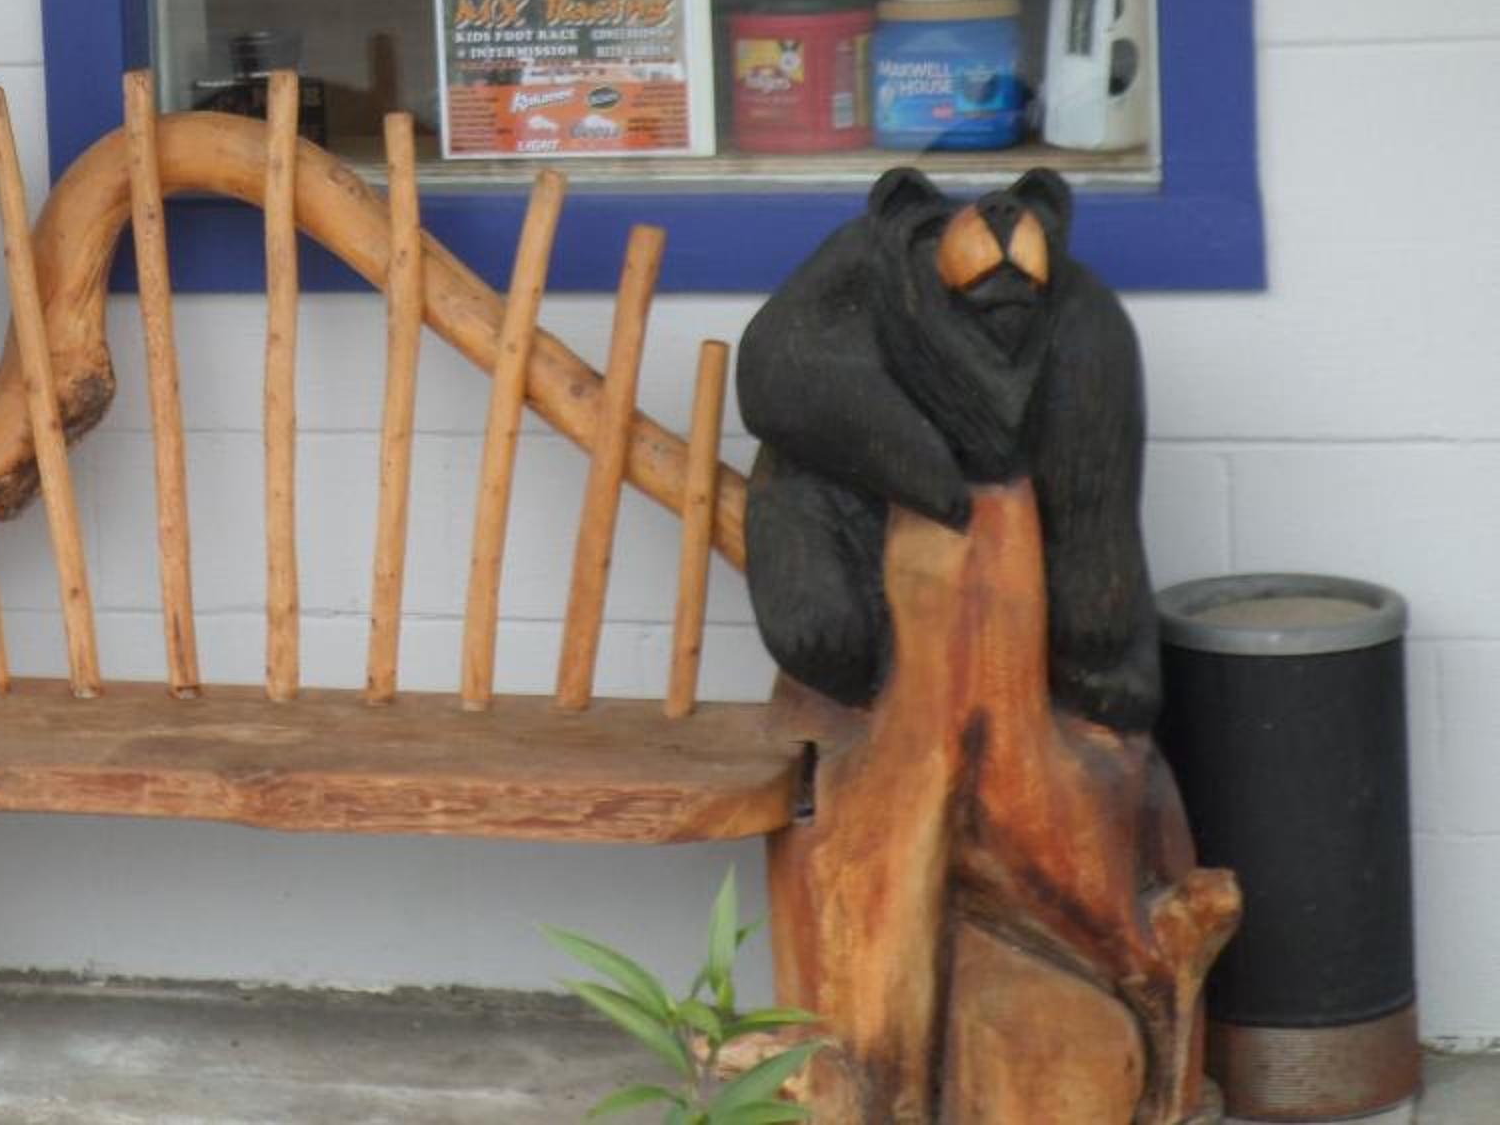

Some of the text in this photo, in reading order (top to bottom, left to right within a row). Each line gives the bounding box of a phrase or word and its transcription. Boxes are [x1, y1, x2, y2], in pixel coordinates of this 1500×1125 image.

[455, 28, 580, 44] KIDS FOOT RACE
[470, 44, 579, 60] INTERMISSION
